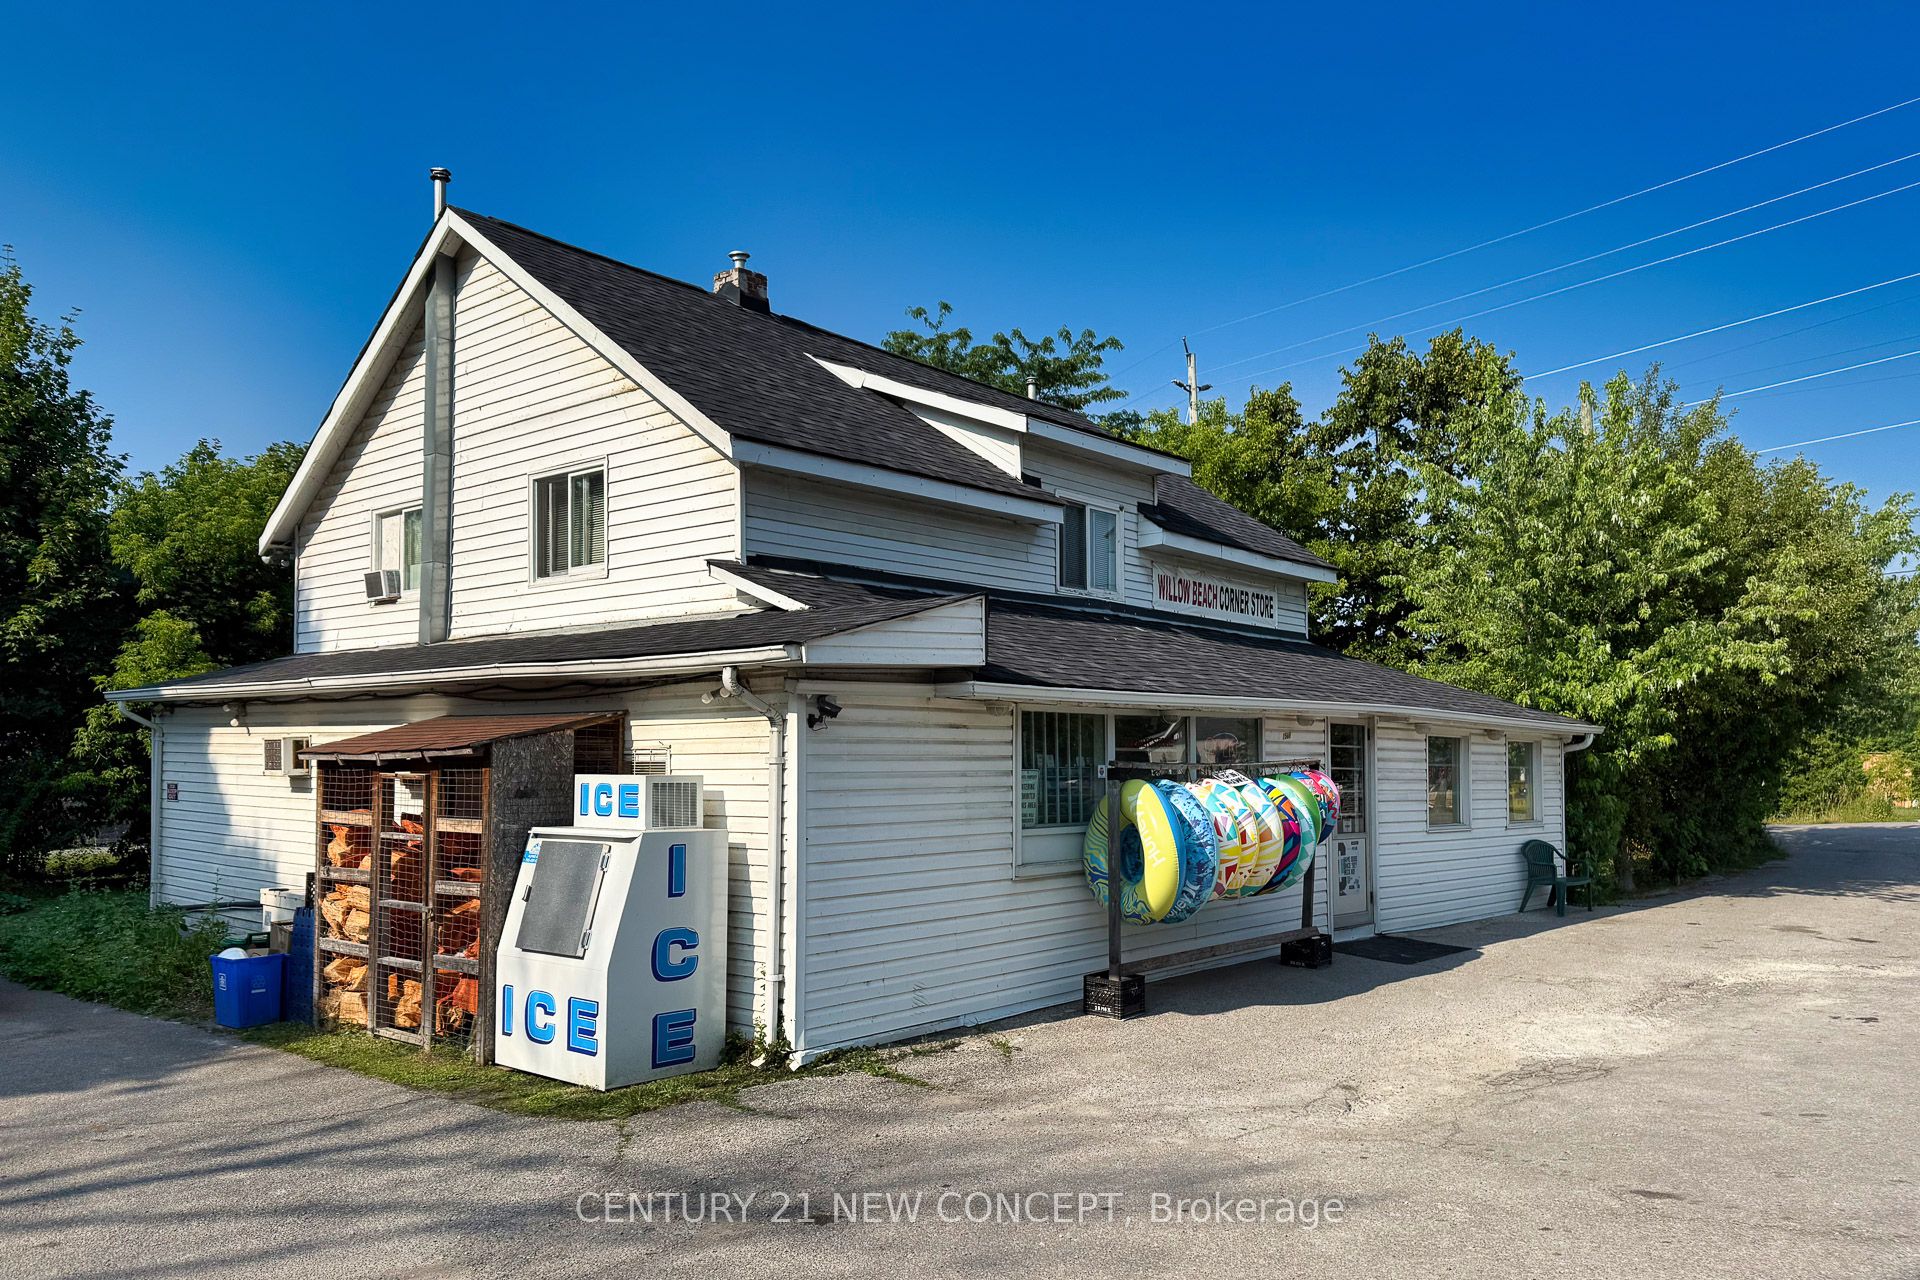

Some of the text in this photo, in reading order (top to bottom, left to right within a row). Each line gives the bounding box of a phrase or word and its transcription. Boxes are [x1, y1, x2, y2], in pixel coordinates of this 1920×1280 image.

[1157, 574, 1274, 619] WILLOW BEACH CORNER STORE
[579, 782, 640, 818] ICE
[651, 843, 700, 1070] ICE
[502, 984, 599, 1057] ICE
